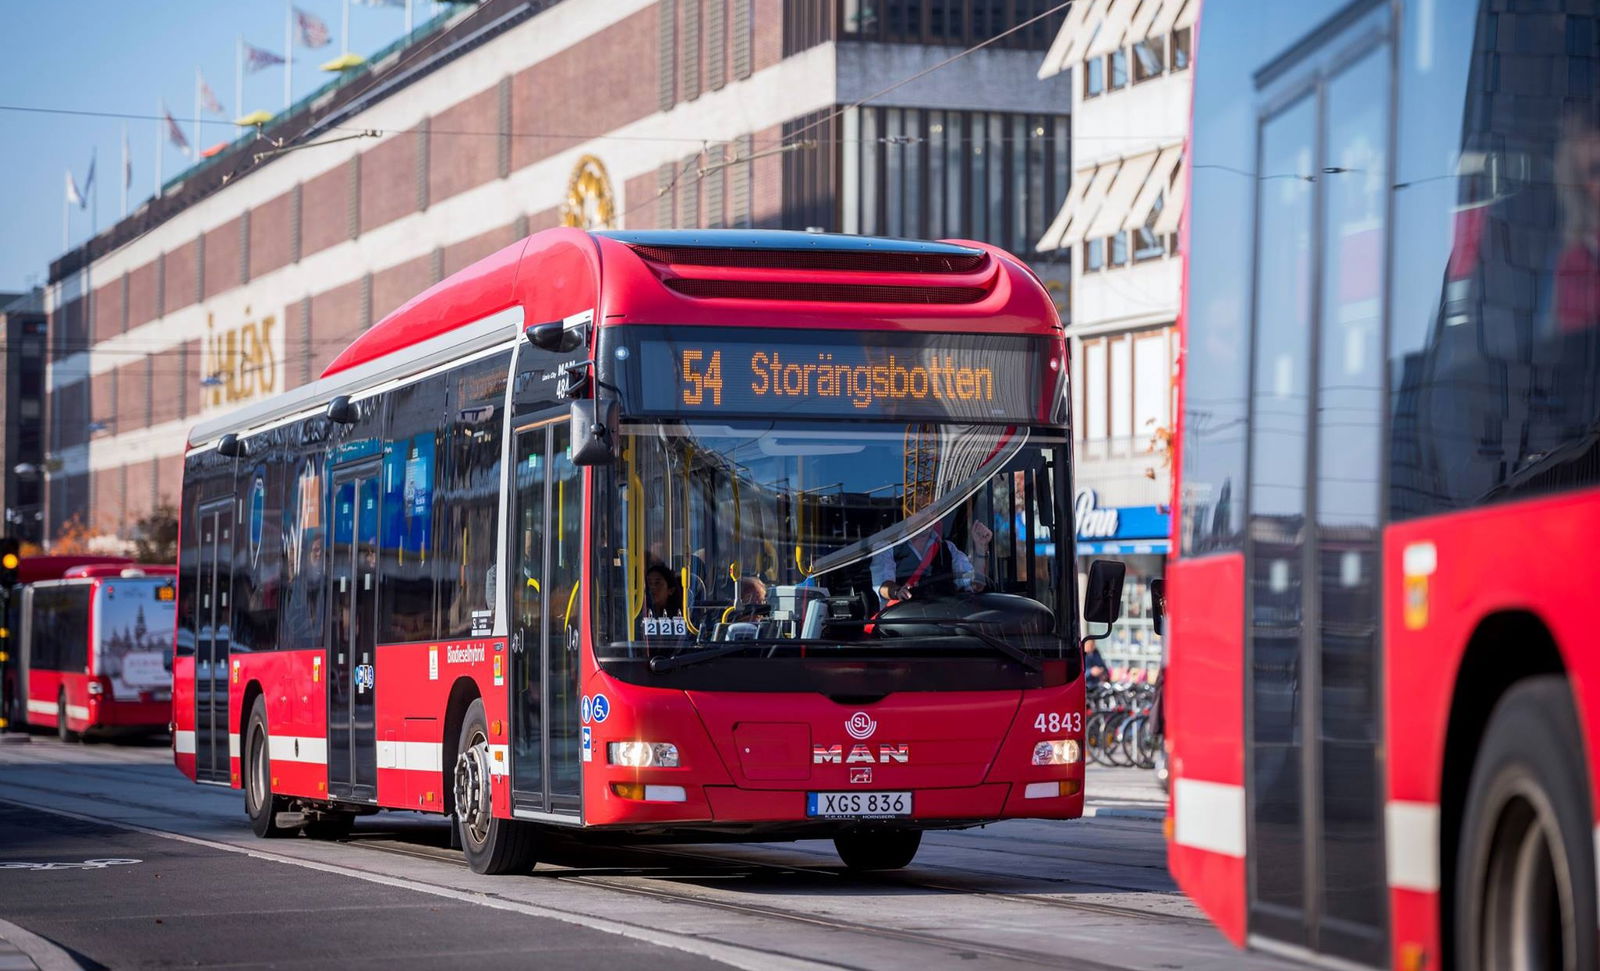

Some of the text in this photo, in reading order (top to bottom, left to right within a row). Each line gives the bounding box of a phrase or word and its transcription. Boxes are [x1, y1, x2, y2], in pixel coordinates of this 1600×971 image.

[683, 350, 993, 408] 54 Storängsbotten
[854, 717, 868, 728] SL
[1034, 711, 1082, 733] 4843
[813, 744, 909, 764] MAN
[825, 795, 904, 813] XGS 836
